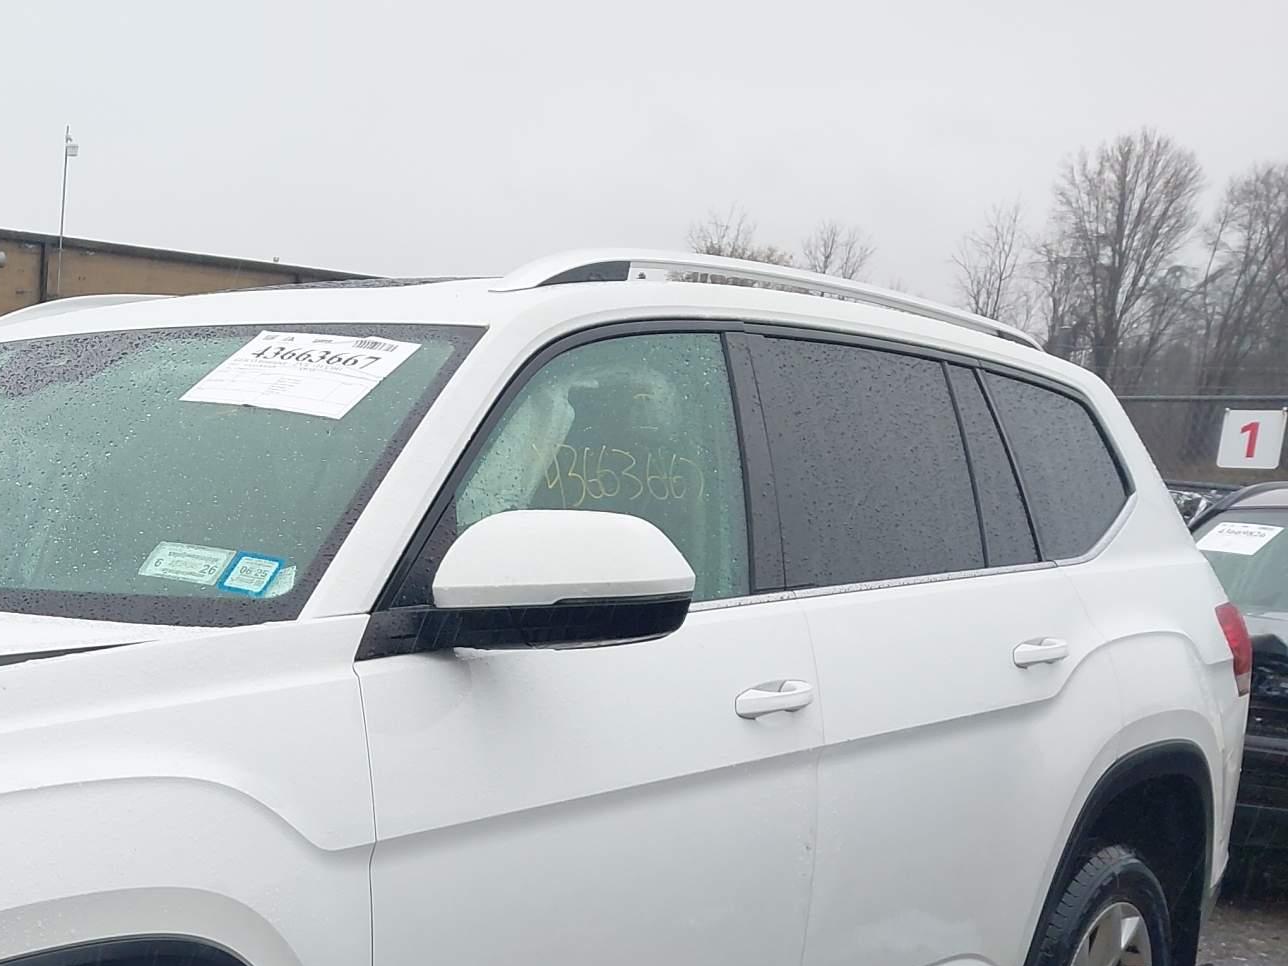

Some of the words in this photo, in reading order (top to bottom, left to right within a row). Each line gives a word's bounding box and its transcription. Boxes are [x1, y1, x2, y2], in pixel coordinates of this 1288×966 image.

[251, 345, 383, 369] 43663667
[1240, 421, 1260, 458] 1
[199, 564, 218, 575] 26
